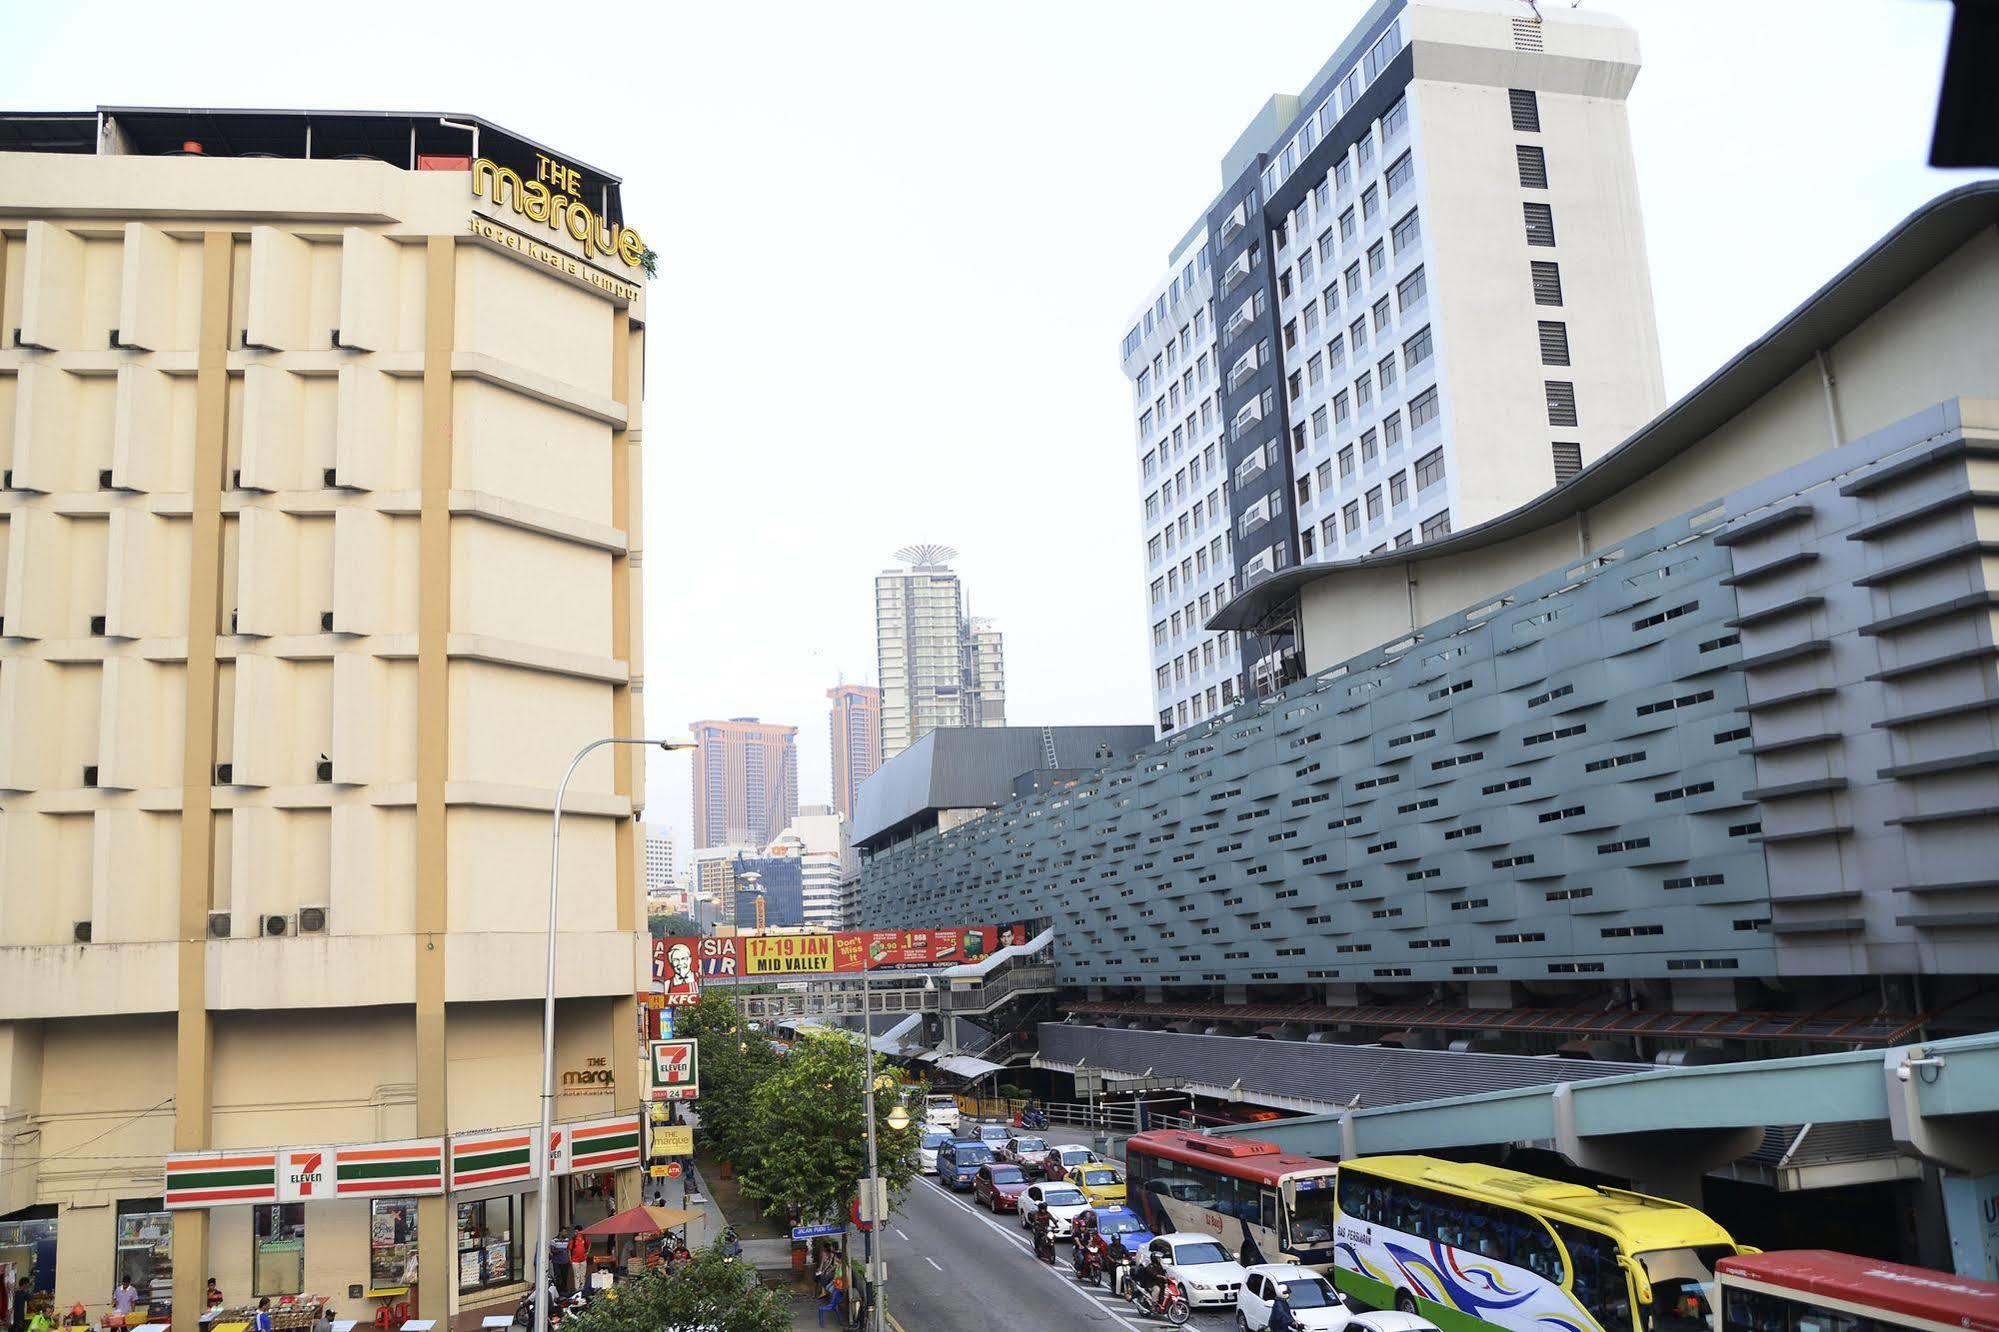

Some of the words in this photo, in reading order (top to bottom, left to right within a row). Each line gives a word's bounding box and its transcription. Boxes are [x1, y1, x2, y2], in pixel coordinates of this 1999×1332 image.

[536, 153, 583, 198] THE
[472, 158, 644, 267] marque
[468, 218, 523, 251] Hotel
[528, 242, 577, 276] Kuala
[582, 266, 640, 302] Lumpur
[697, 939, 736, 956] SIA
[750, 938, 794, 957] 17-19
[800, 937, 829, 955] JAN
[836, 936, 862, 947] Don't
[841, 945, 863, 955] Miss
[757, 958, 781, 971] MID
[785, 957, 828, 970] VALLEY
[667, 994, 697, 1005] KFC
[587, 1057, 607, 1067] THE
[660, 1046, 687, 1083] 7
[669, 1090, 680, 1098] 24
[655, 1136, 689, 1147] marque
[291, 1153, 322, 1195] 7
